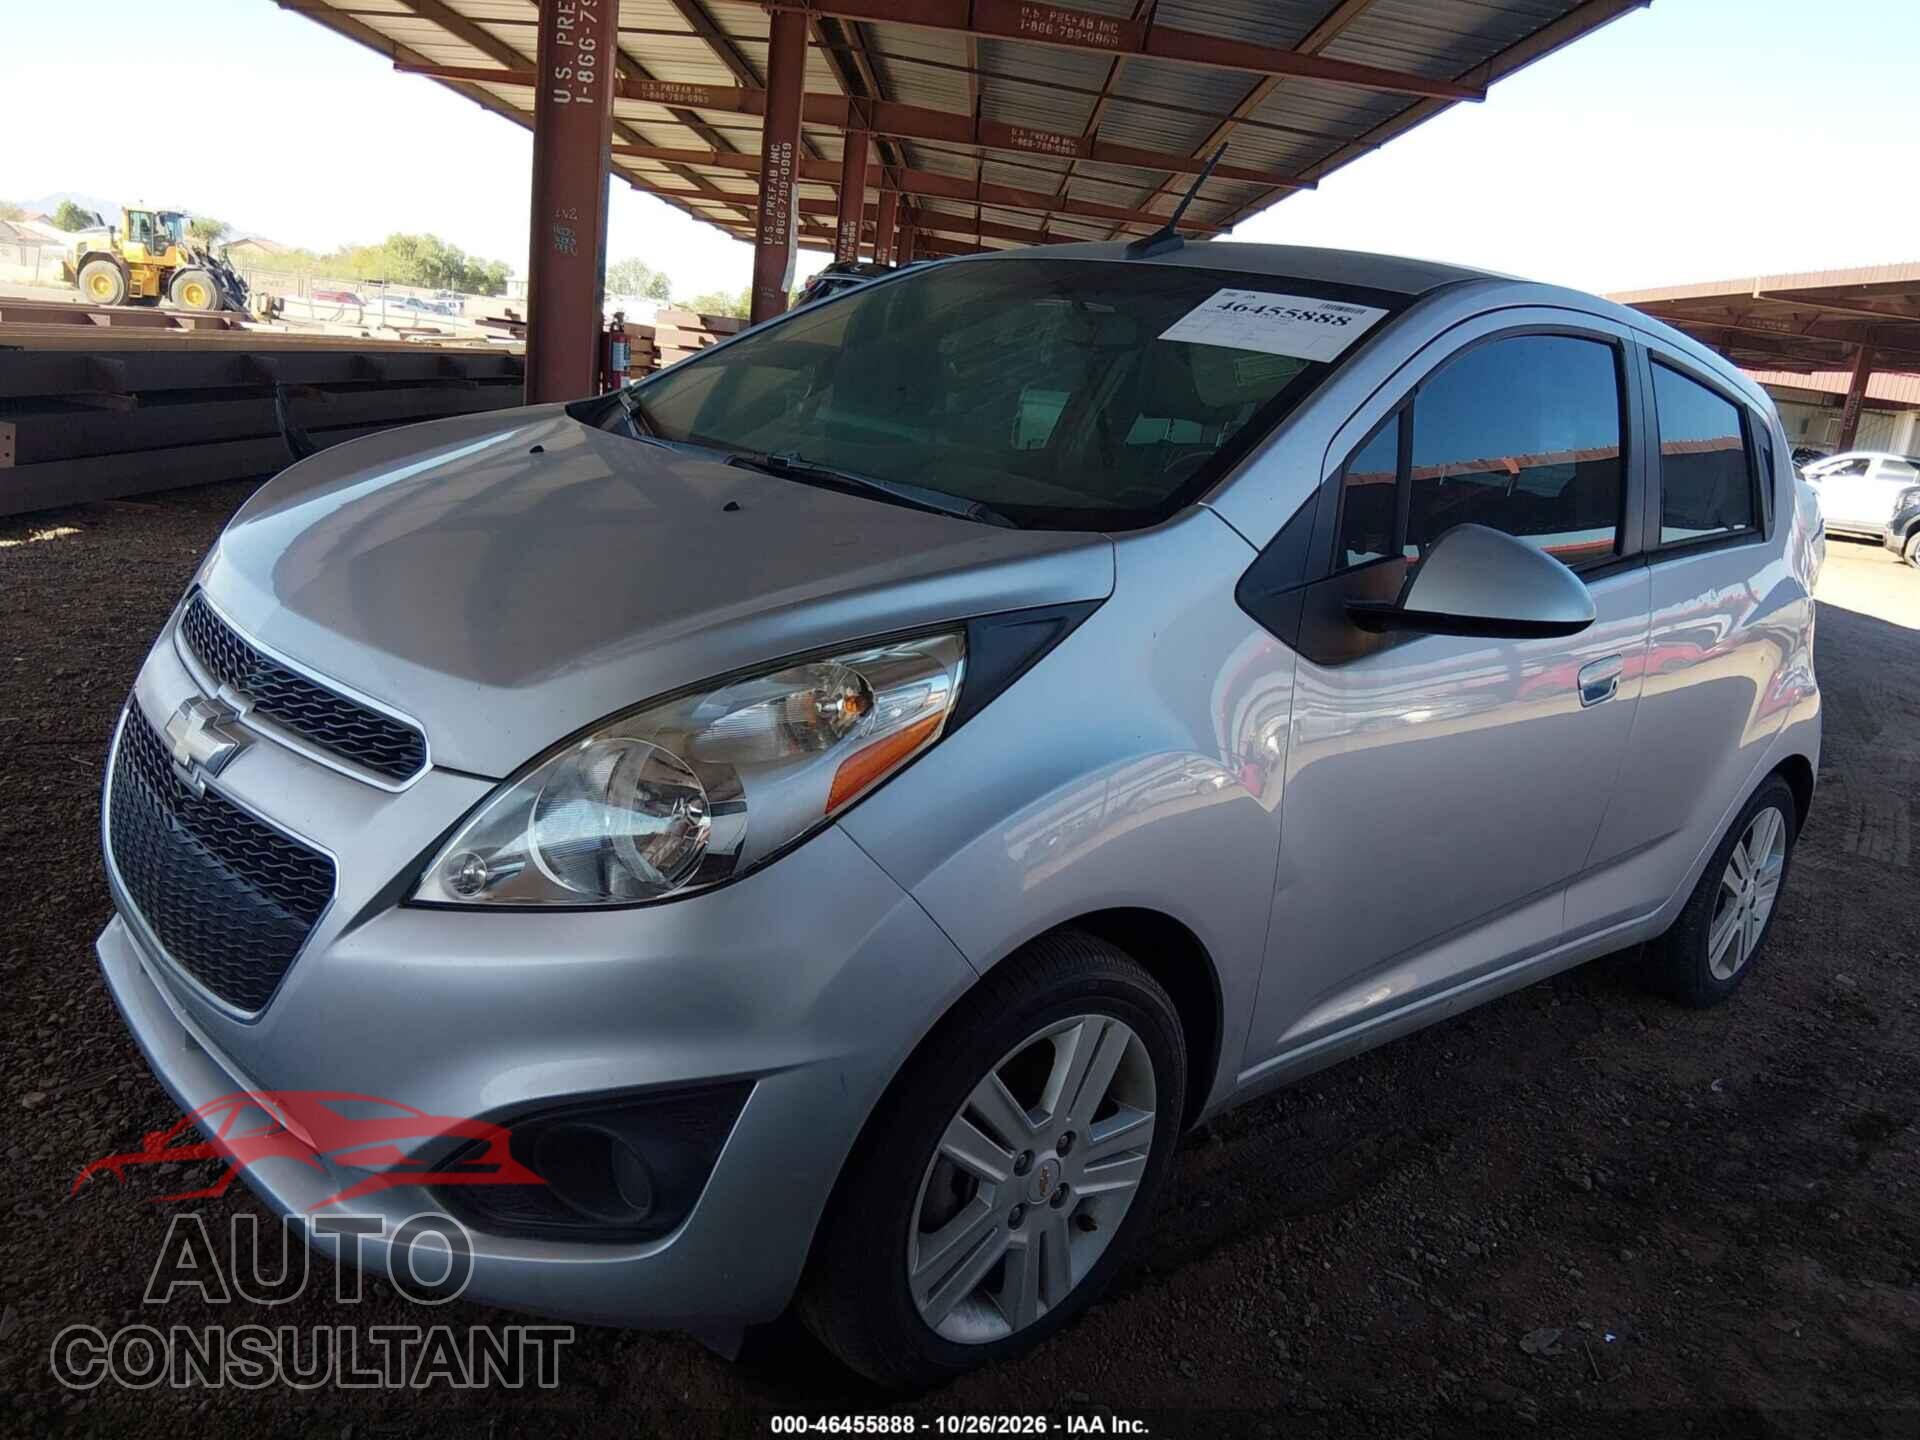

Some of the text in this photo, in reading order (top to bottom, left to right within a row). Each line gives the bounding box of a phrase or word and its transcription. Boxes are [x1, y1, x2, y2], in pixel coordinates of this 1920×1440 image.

[553, 1, 575, 104] U.S. PRE
[770, 143, 781, 164] INC
[766, 170, 779, 216] PREFAB
[1216, 300, 1353, 327] 46455888
